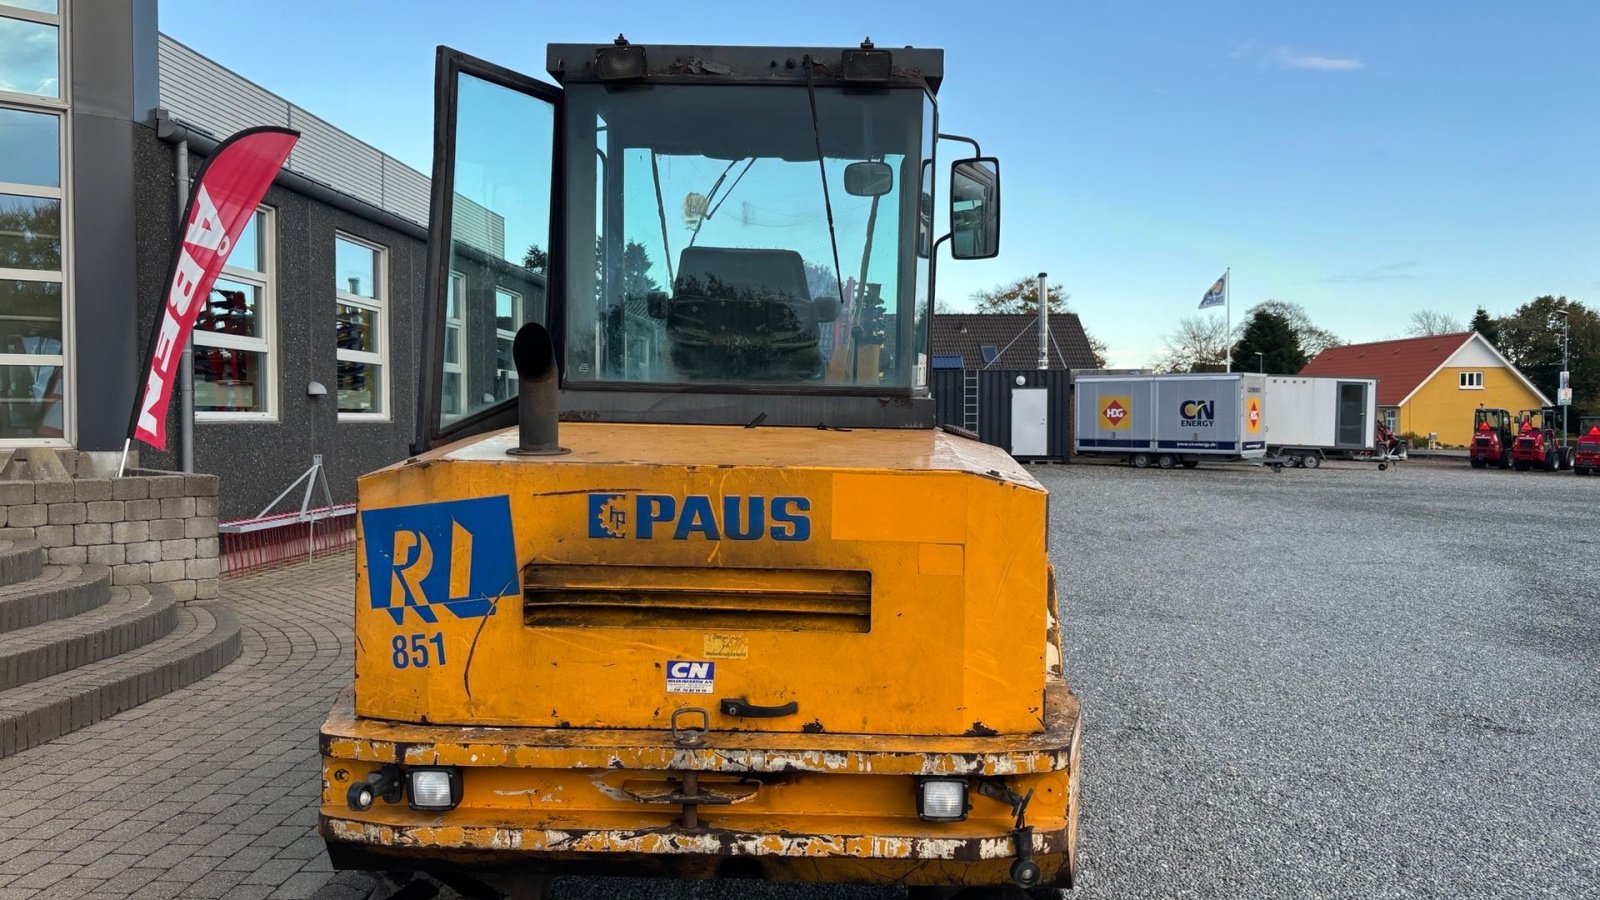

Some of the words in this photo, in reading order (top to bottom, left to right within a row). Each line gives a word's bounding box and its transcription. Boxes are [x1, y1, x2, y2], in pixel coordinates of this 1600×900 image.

[136, 182, 231, 437] ÅBEN
[1106, 408, 1124, 418] HDG
[1180, 400, 1214, 419] CN
[635, 494, 811, 542] PAUS
[392, 631, 446, 669] 851
[671, 662, 710, 679] CN
